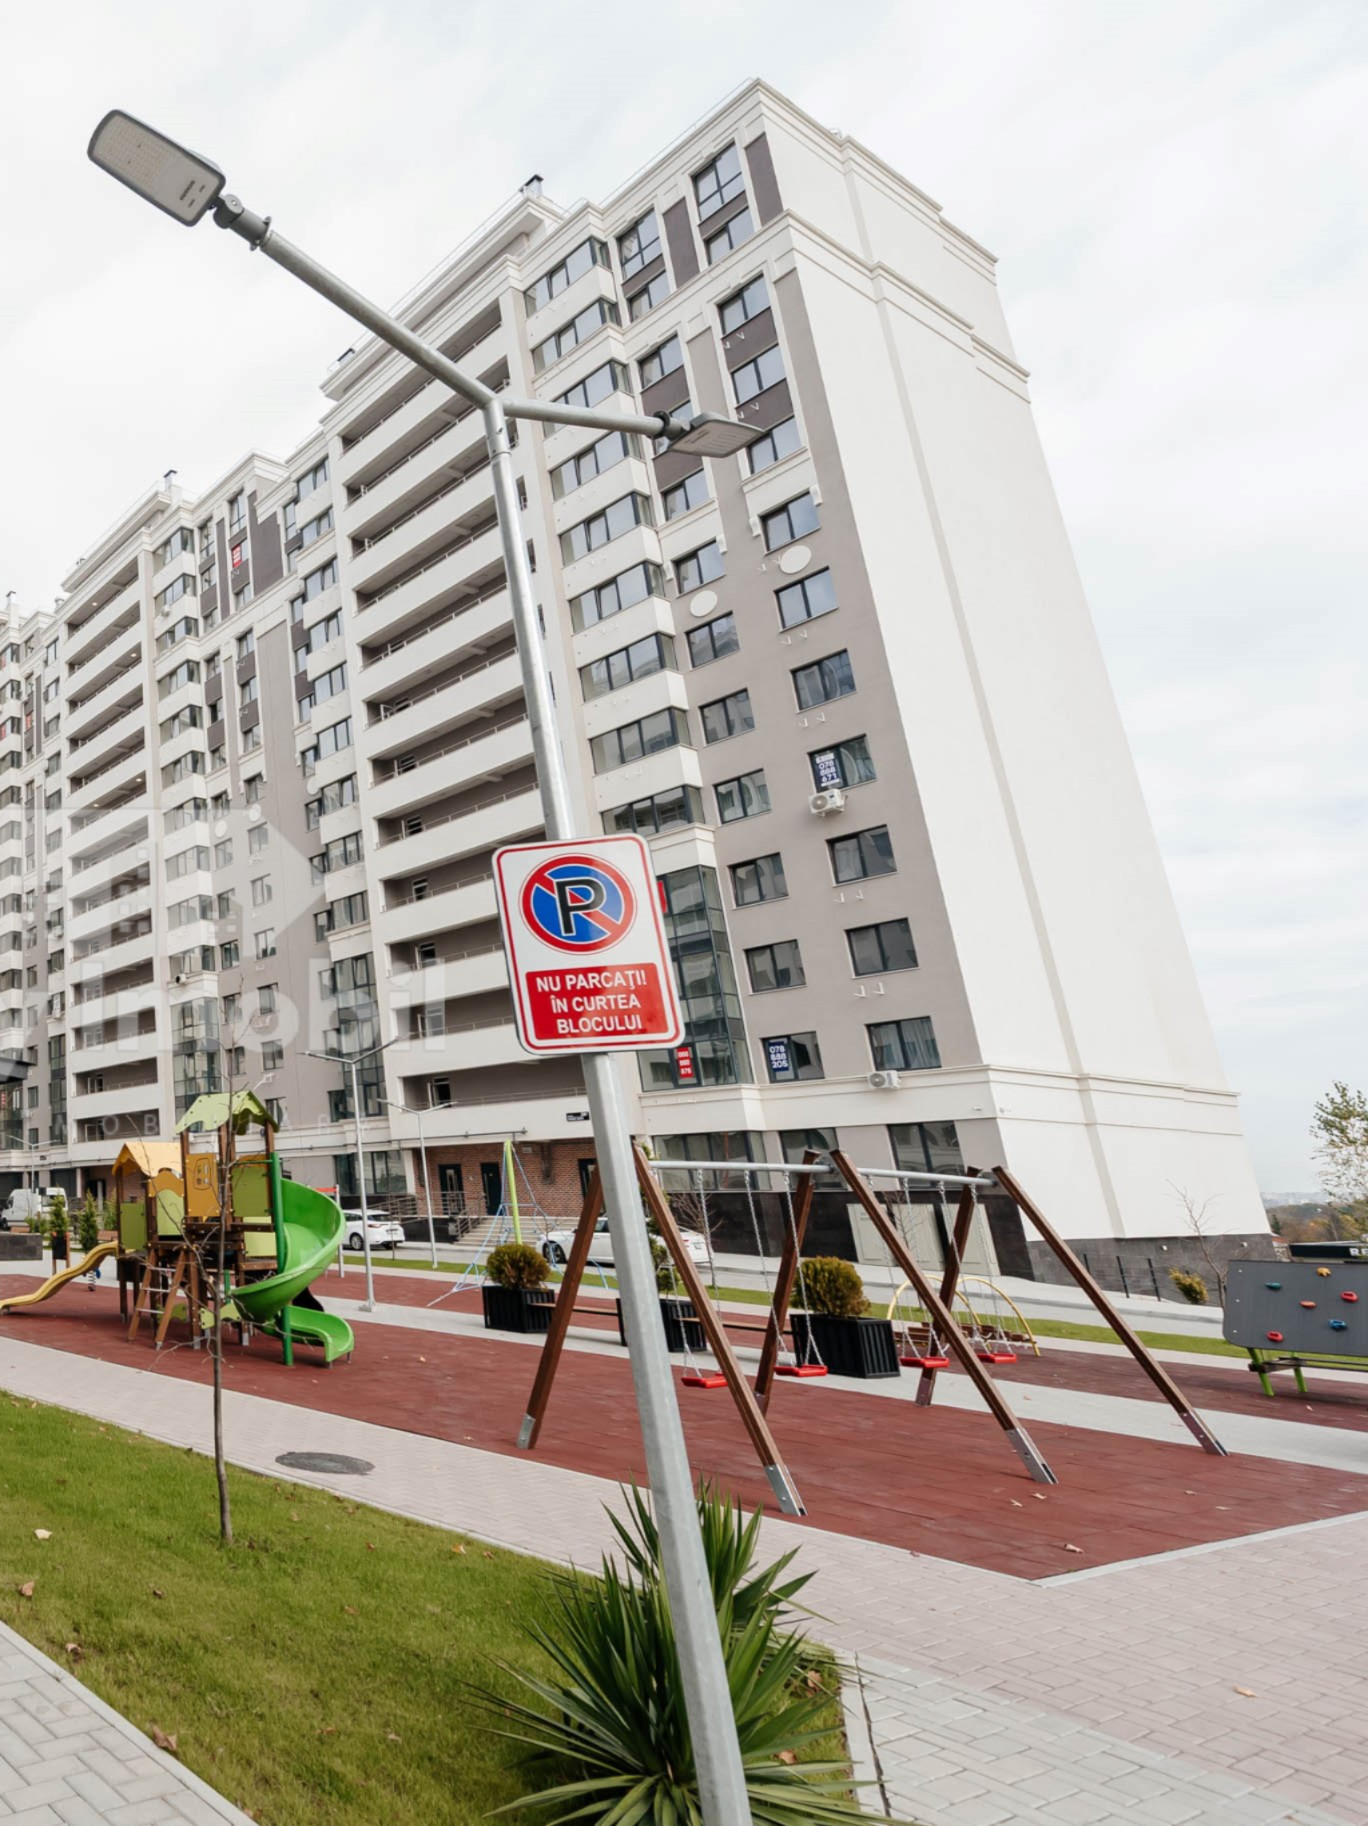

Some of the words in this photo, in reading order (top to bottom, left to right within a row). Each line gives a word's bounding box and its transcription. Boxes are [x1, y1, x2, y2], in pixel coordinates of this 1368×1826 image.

[536, 976, 561, 993] NU
[551, 995, 569, 1014] ÎN
[572, 993, 641, 1012] CURTEA
[557, 1014, 643, 1034] BLOCULUI
